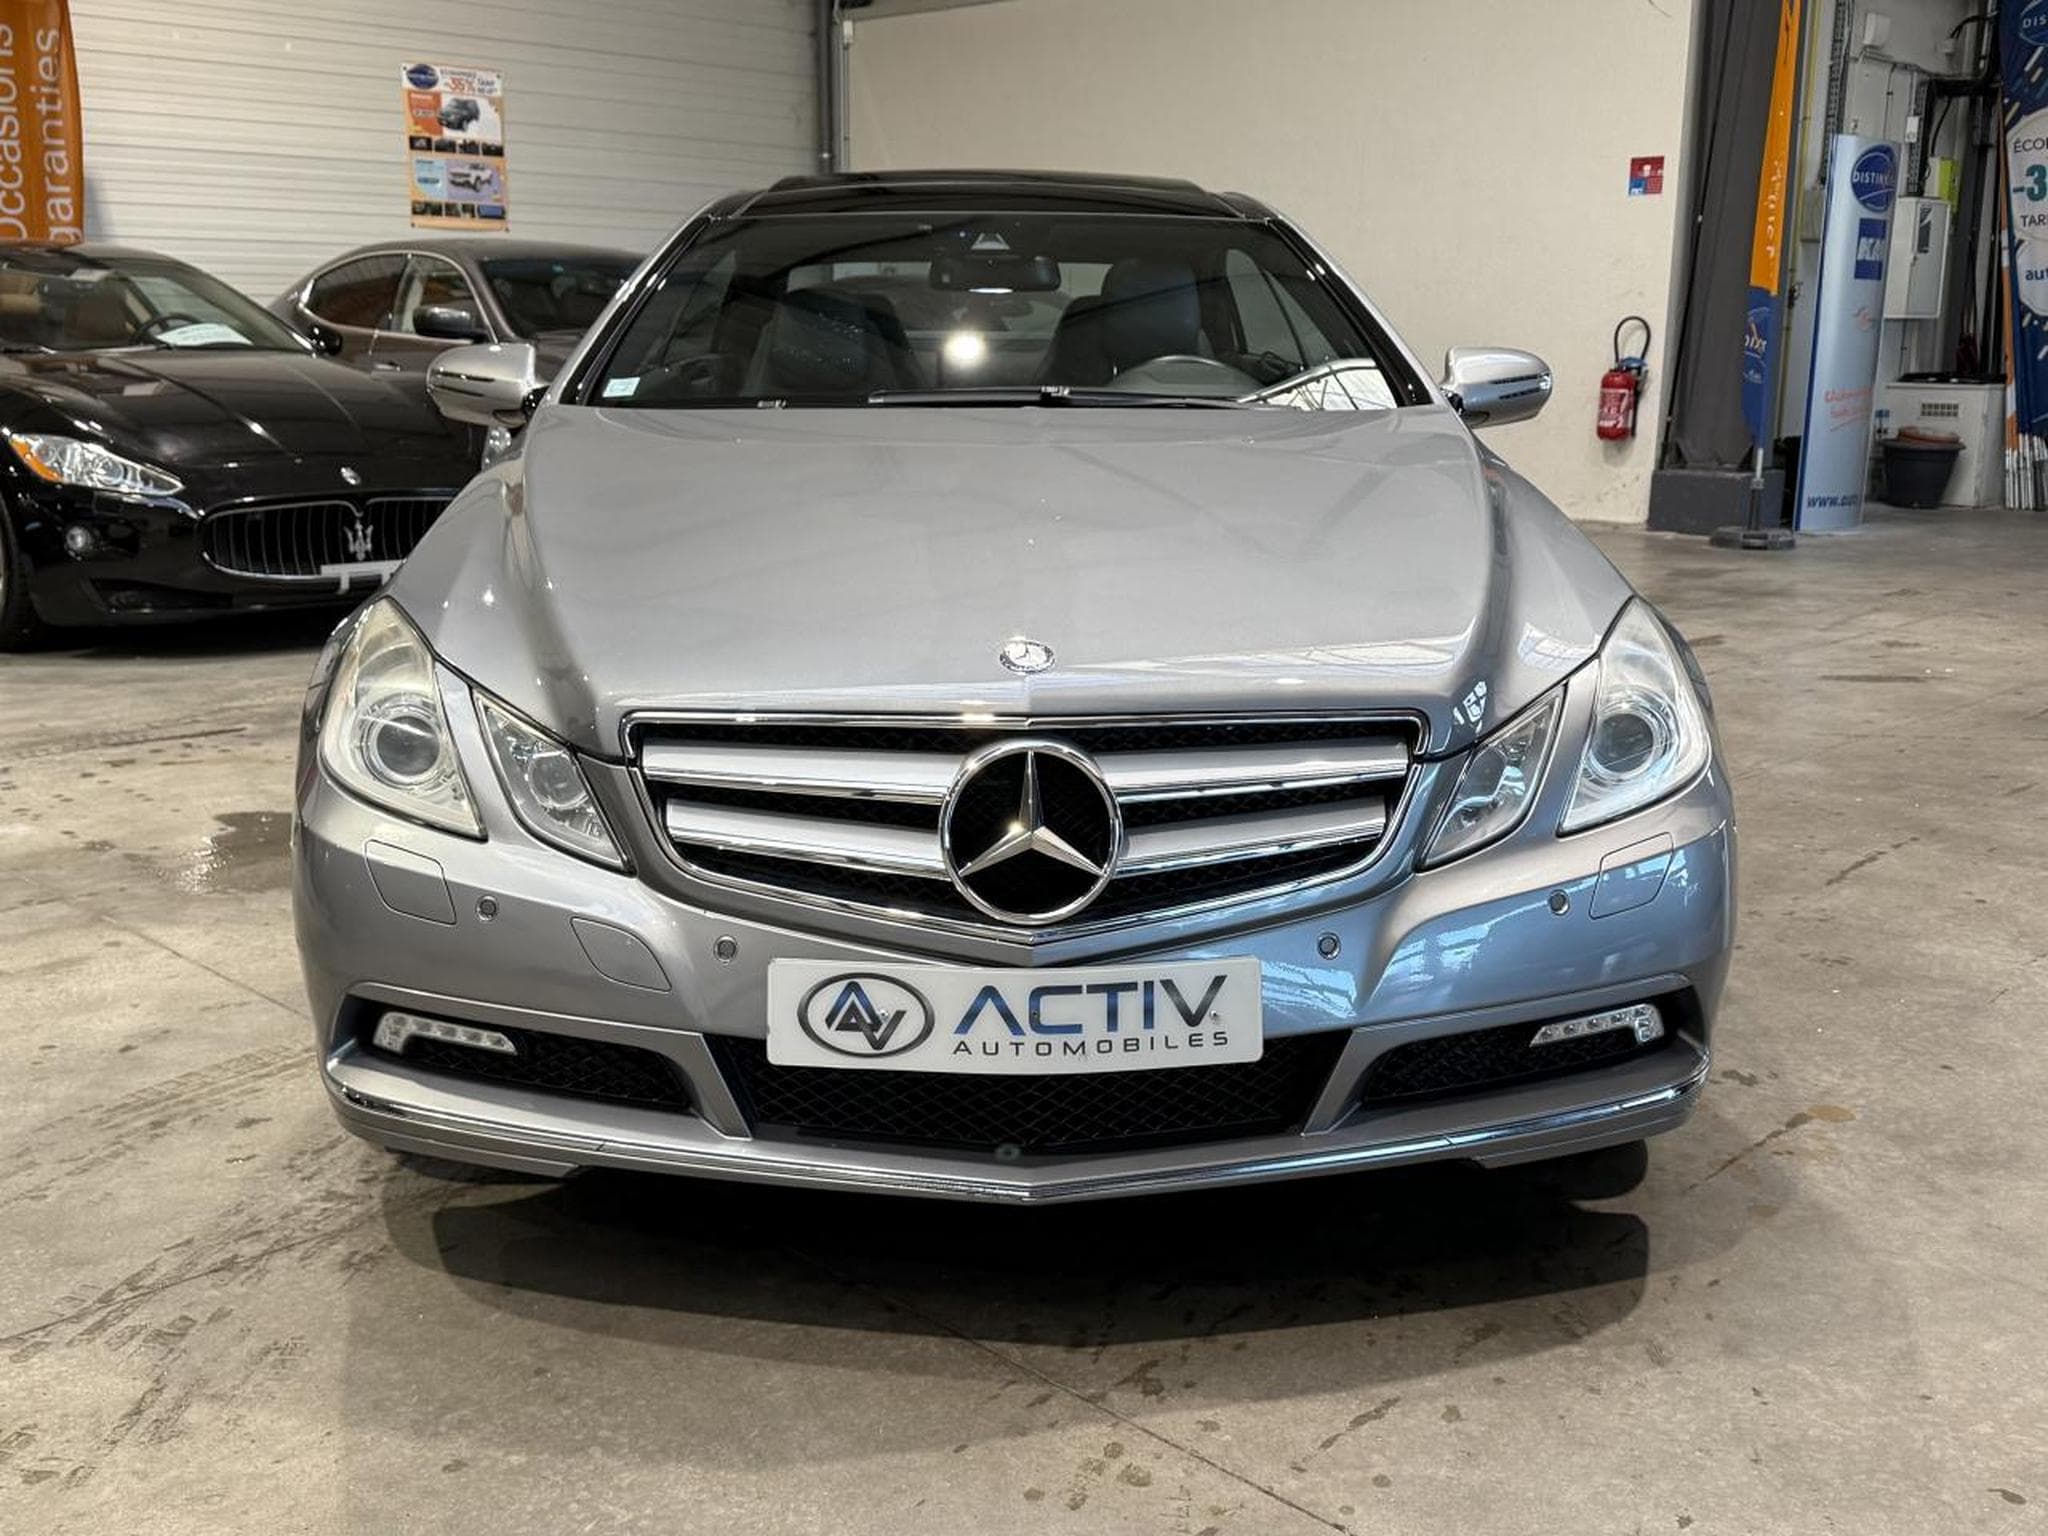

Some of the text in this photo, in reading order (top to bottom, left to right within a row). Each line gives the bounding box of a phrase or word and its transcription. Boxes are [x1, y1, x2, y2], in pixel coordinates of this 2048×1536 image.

[30, 28, 83, 244] garanties
[953, 974, 1229, 1036] ACTIV
[952, 1031, 1230, 1057] AUTOMOBILES
